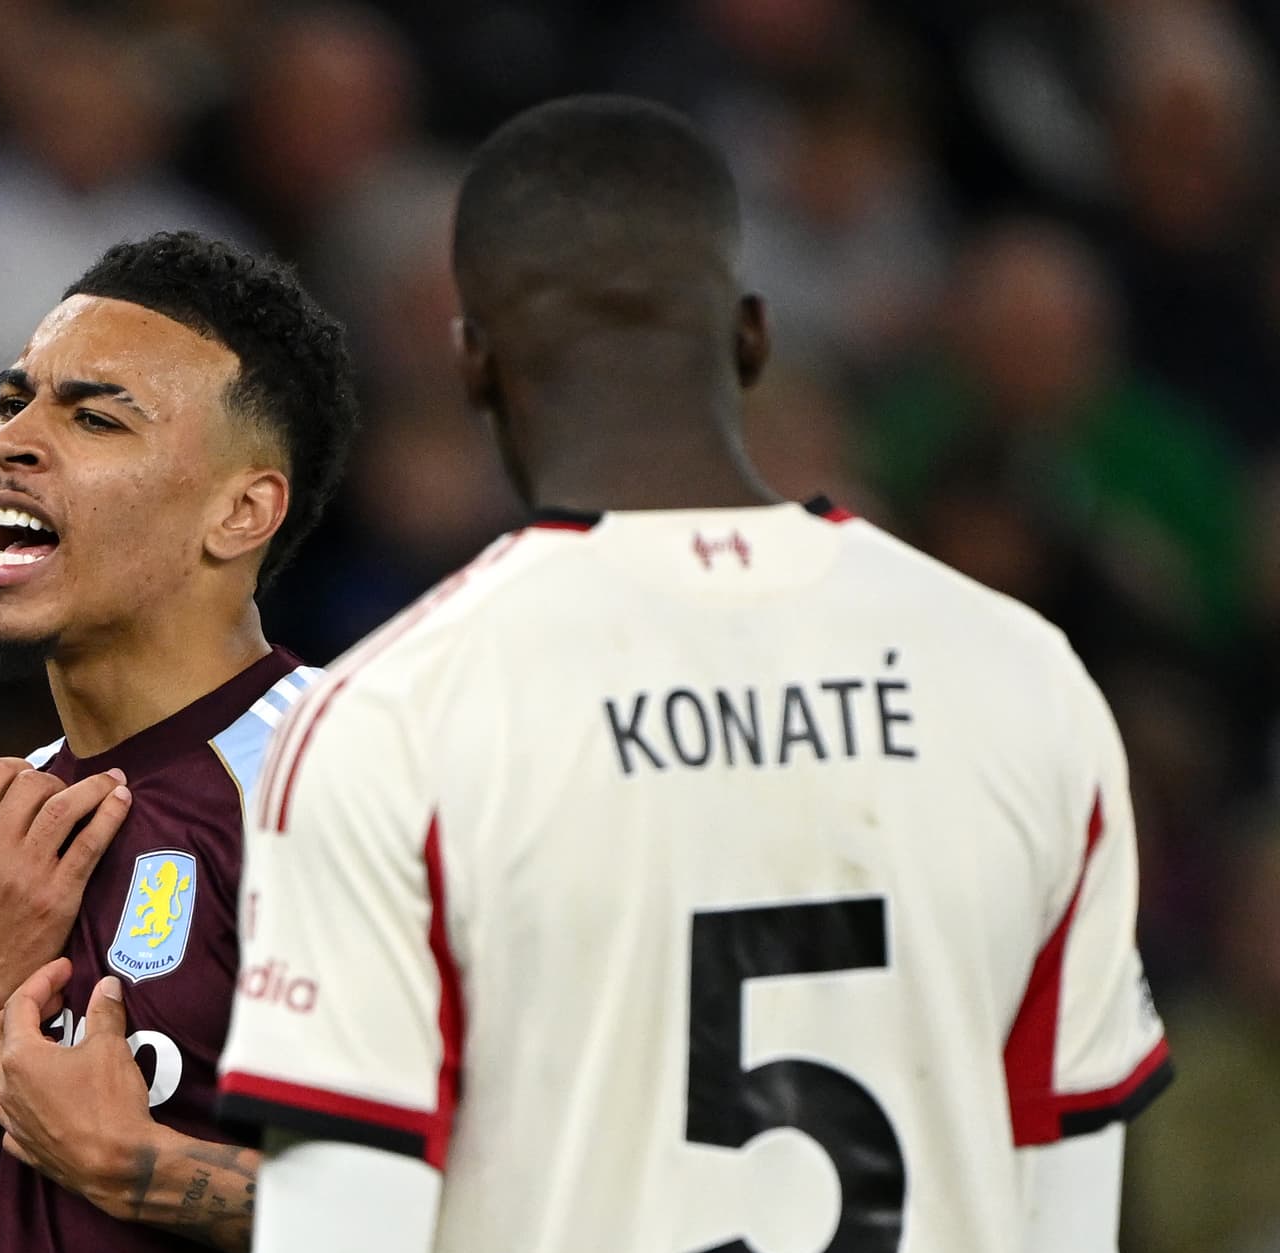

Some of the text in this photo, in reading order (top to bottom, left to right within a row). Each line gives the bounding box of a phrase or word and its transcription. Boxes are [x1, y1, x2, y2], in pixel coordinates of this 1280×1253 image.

[604, 647, 917, 776] KONATÉ
[114, 950, 144, 970] ASTON
[145, 954, 175, 970] VILLA
